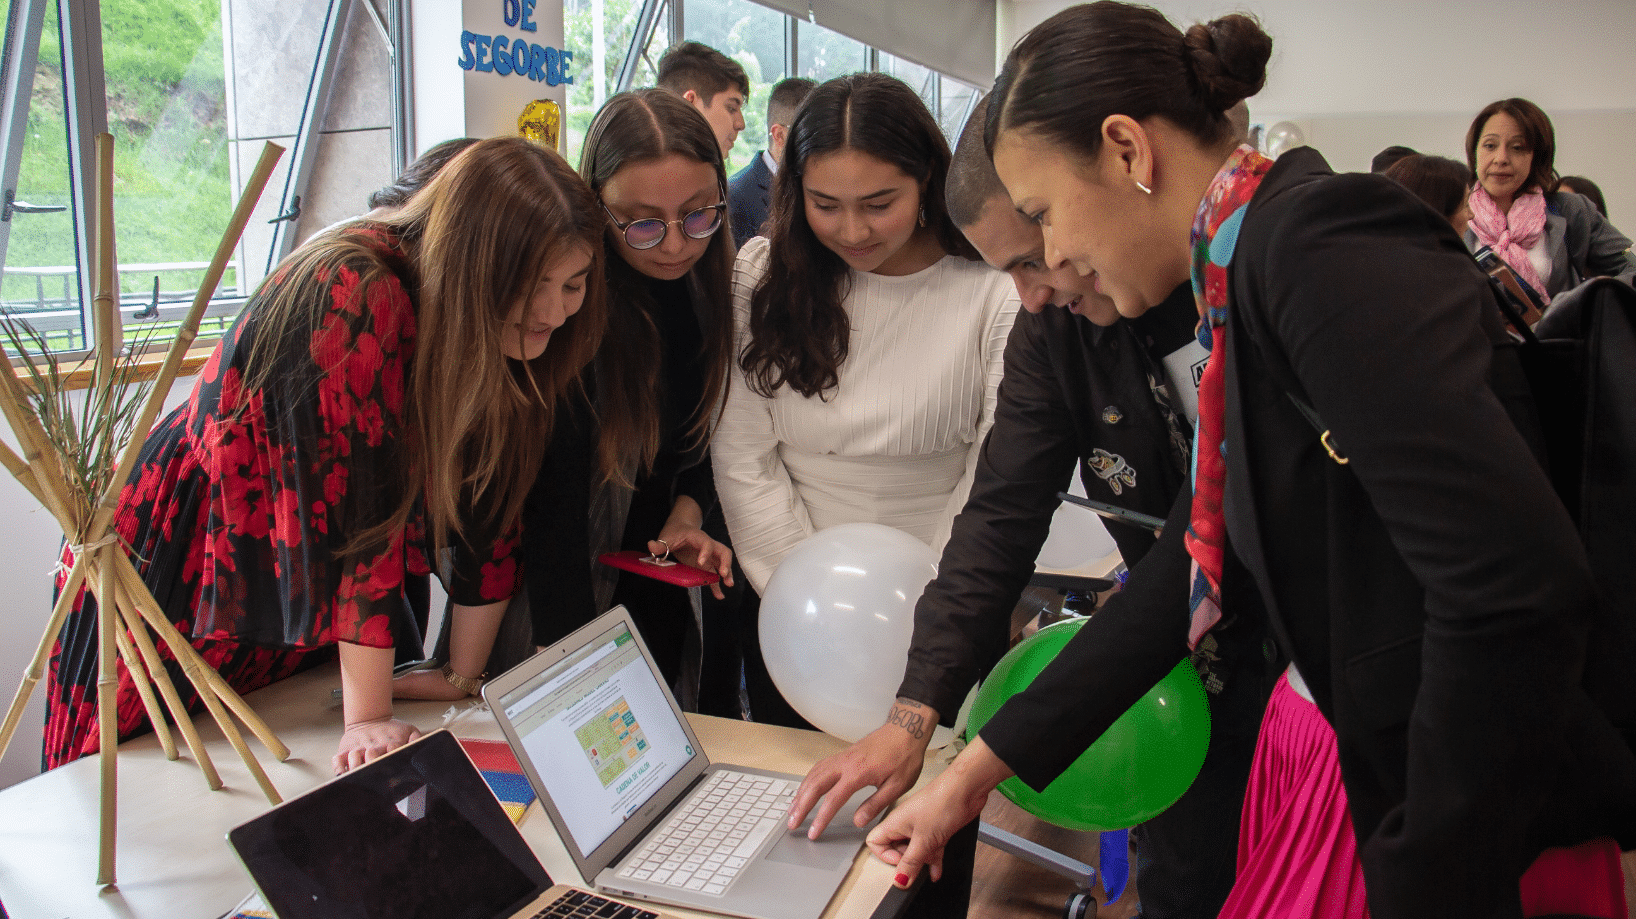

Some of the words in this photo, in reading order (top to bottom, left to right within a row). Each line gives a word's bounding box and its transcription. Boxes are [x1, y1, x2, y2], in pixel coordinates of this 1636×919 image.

[503, 0, 537, 32] DE
[458, 30, 574, 87] SEGORBE
[616, 777, 633, 794] CADENA
[637, 761, 651, 775] VALOR
